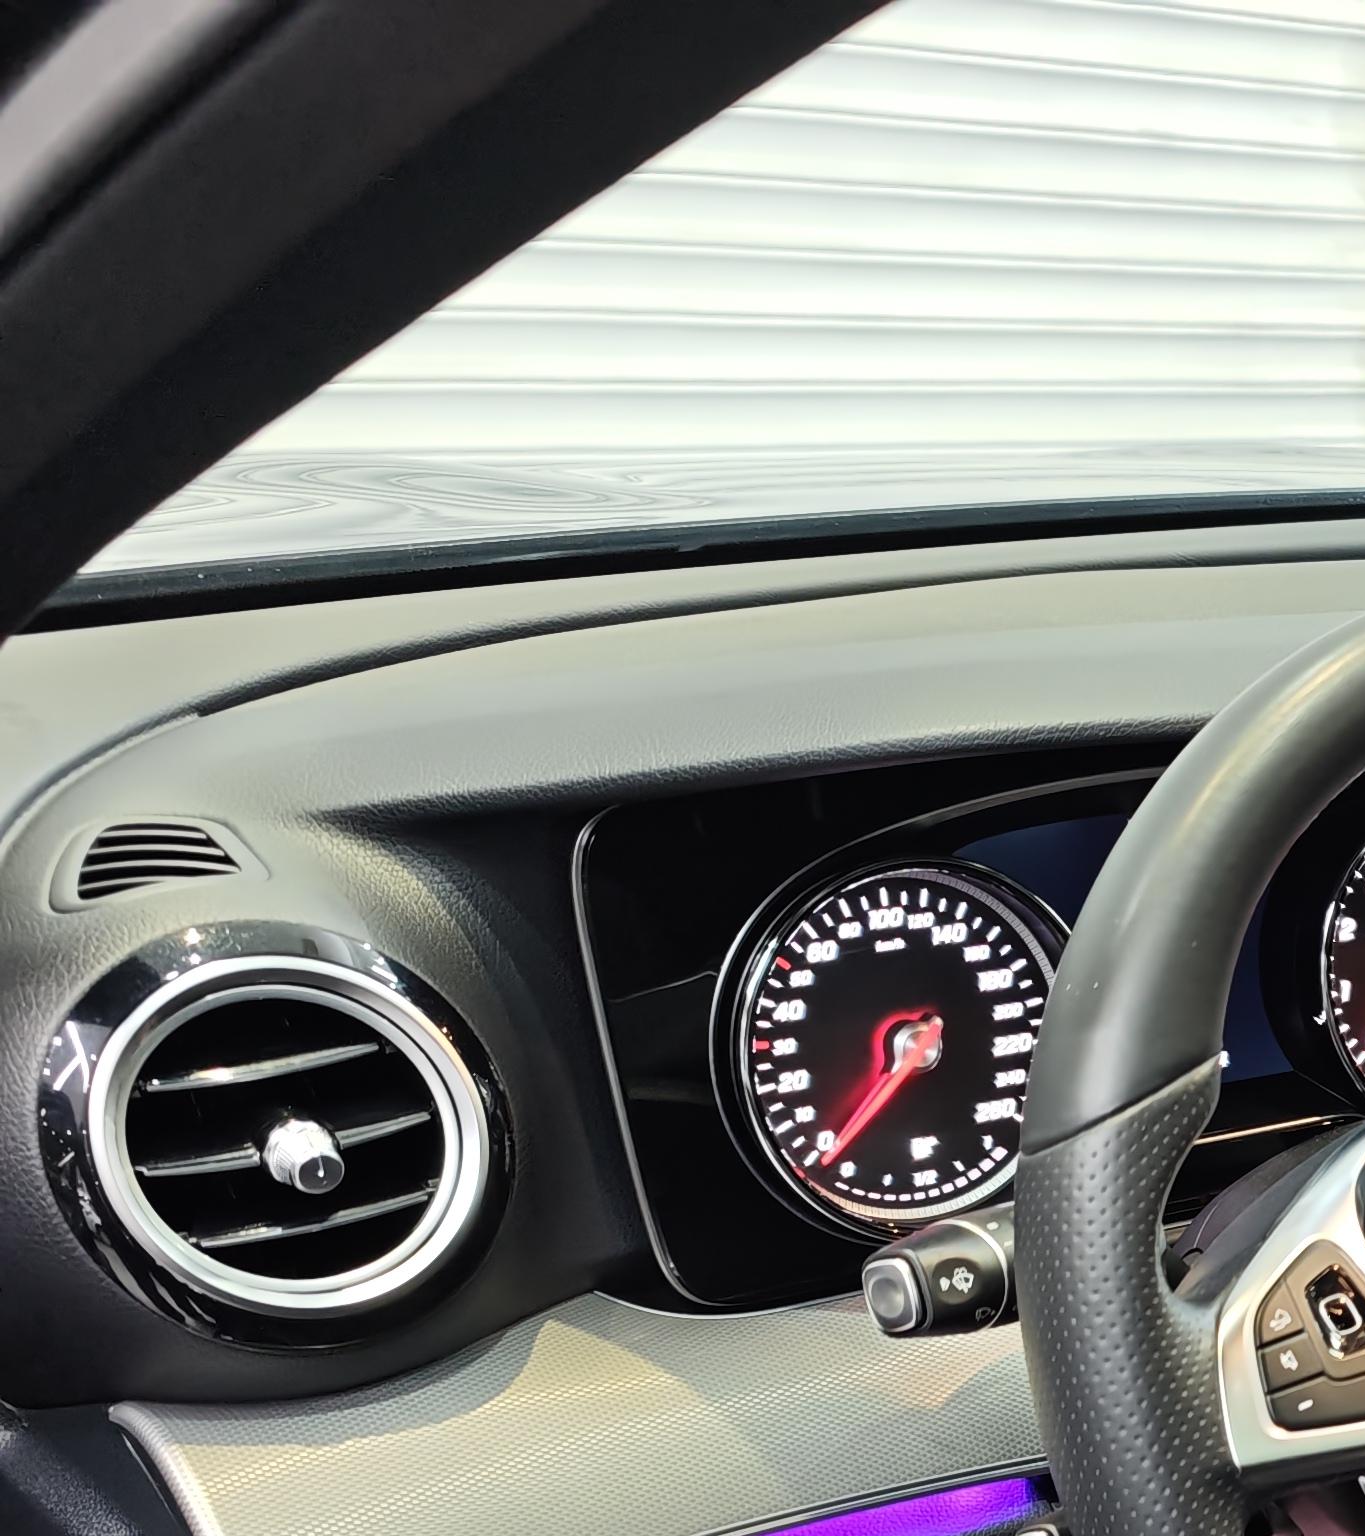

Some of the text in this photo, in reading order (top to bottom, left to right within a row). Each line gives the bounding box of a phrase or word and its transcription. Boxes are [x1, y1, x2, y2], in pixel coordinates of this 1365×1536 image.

[868, 907, 905, 930] 100
[907, 912, 935, 929] 120
[838, 921, 863, 939] 80
[931, 924, 967, 946] 140
[1337, 917, 1358, 943] 2
[806, 939, 839, 963] 60
[789, 969, 815, 988] 50
[1340, 980, 1352, 1003] 1
[772, 999, 806, 1022] 40
[772, 1037, 798, 1056] 30
[992, 1033, 1033, 1057] 220
[777, 1069, 811, 1094] 20
[994, 1069, 1026, 1088] 240
[794, 1105, 816, 1123] 10
[974, 1098, 1018, 1124] 260
[816, 1130, 836, 1152] 0
